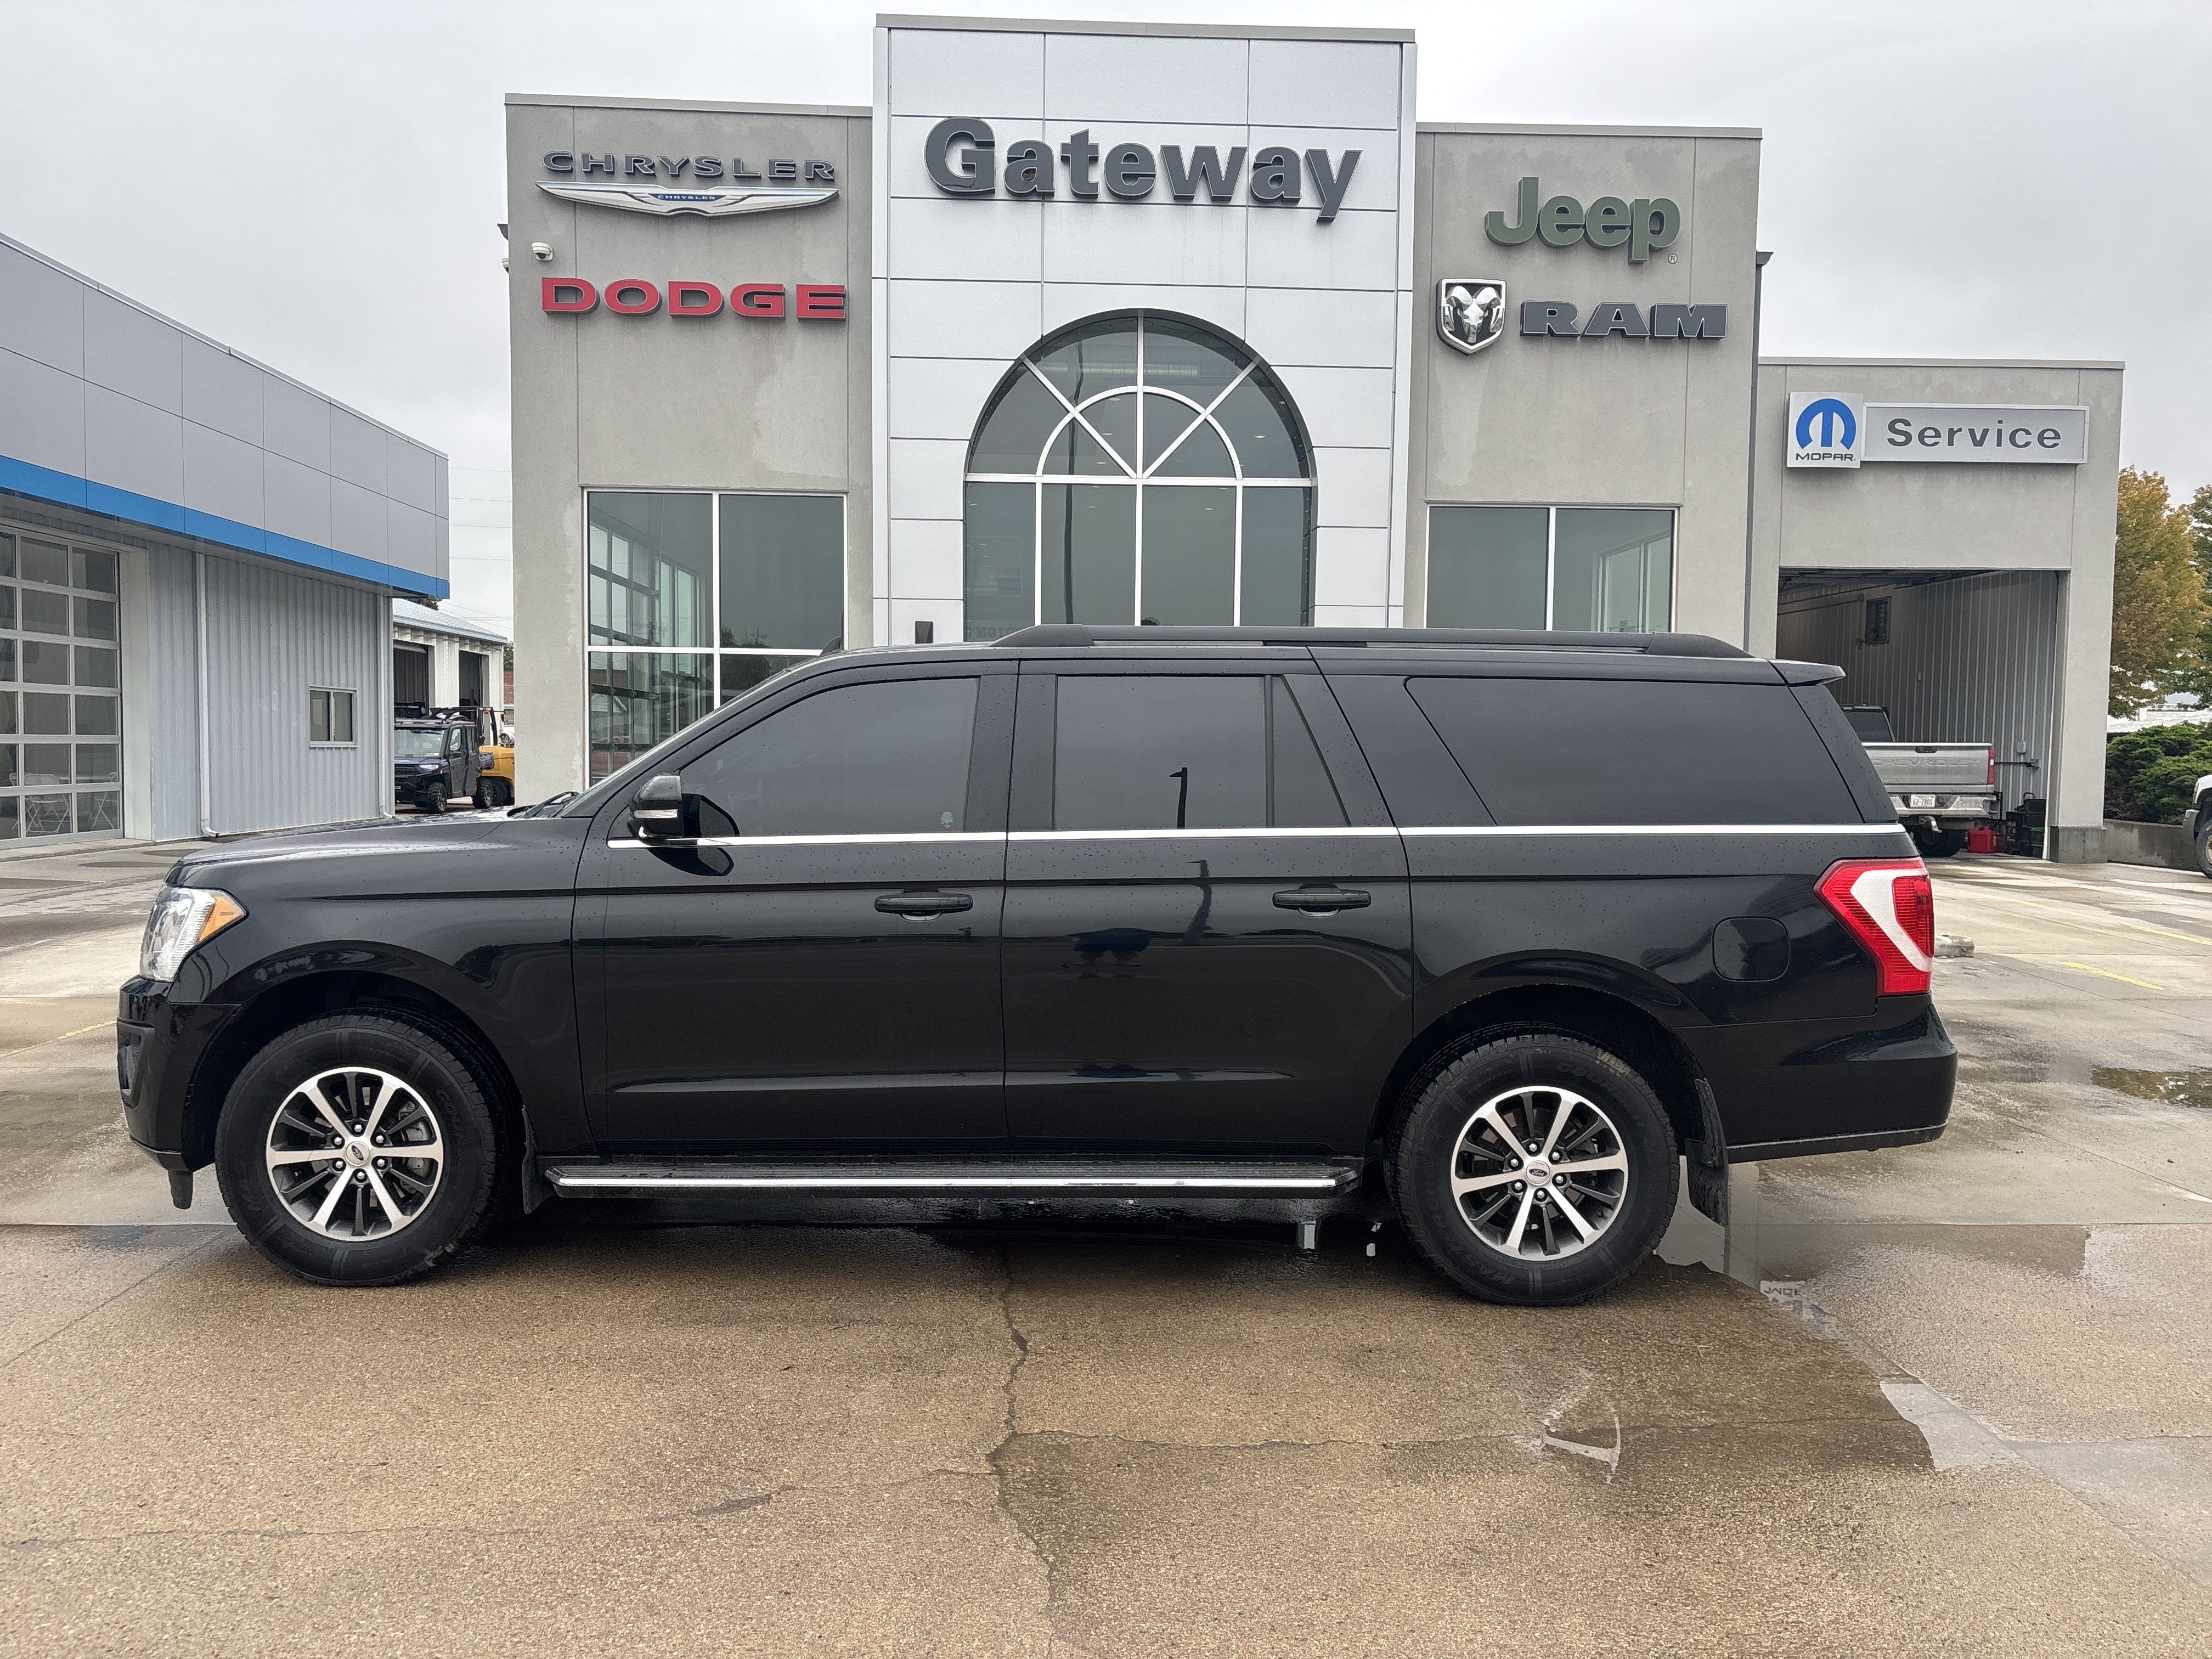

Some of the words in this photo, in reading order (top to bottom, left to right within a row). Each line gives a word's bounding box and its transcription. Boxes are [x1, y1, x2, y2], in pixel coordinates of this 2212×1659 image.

[543, 150, 834, 180] CHRYSLER
[924, 117, 1363, 222] Gateway
[1485, 176, 1680, 264] Jeep
[541, 276, 846, 319] DODGE
[1520, 300, 1728, 340] RAM
[1887, 418, 2062, 449] Service
[1796, 453, 1856, 461] MOPAR
[976, 627, 1020, 638] MOTO
